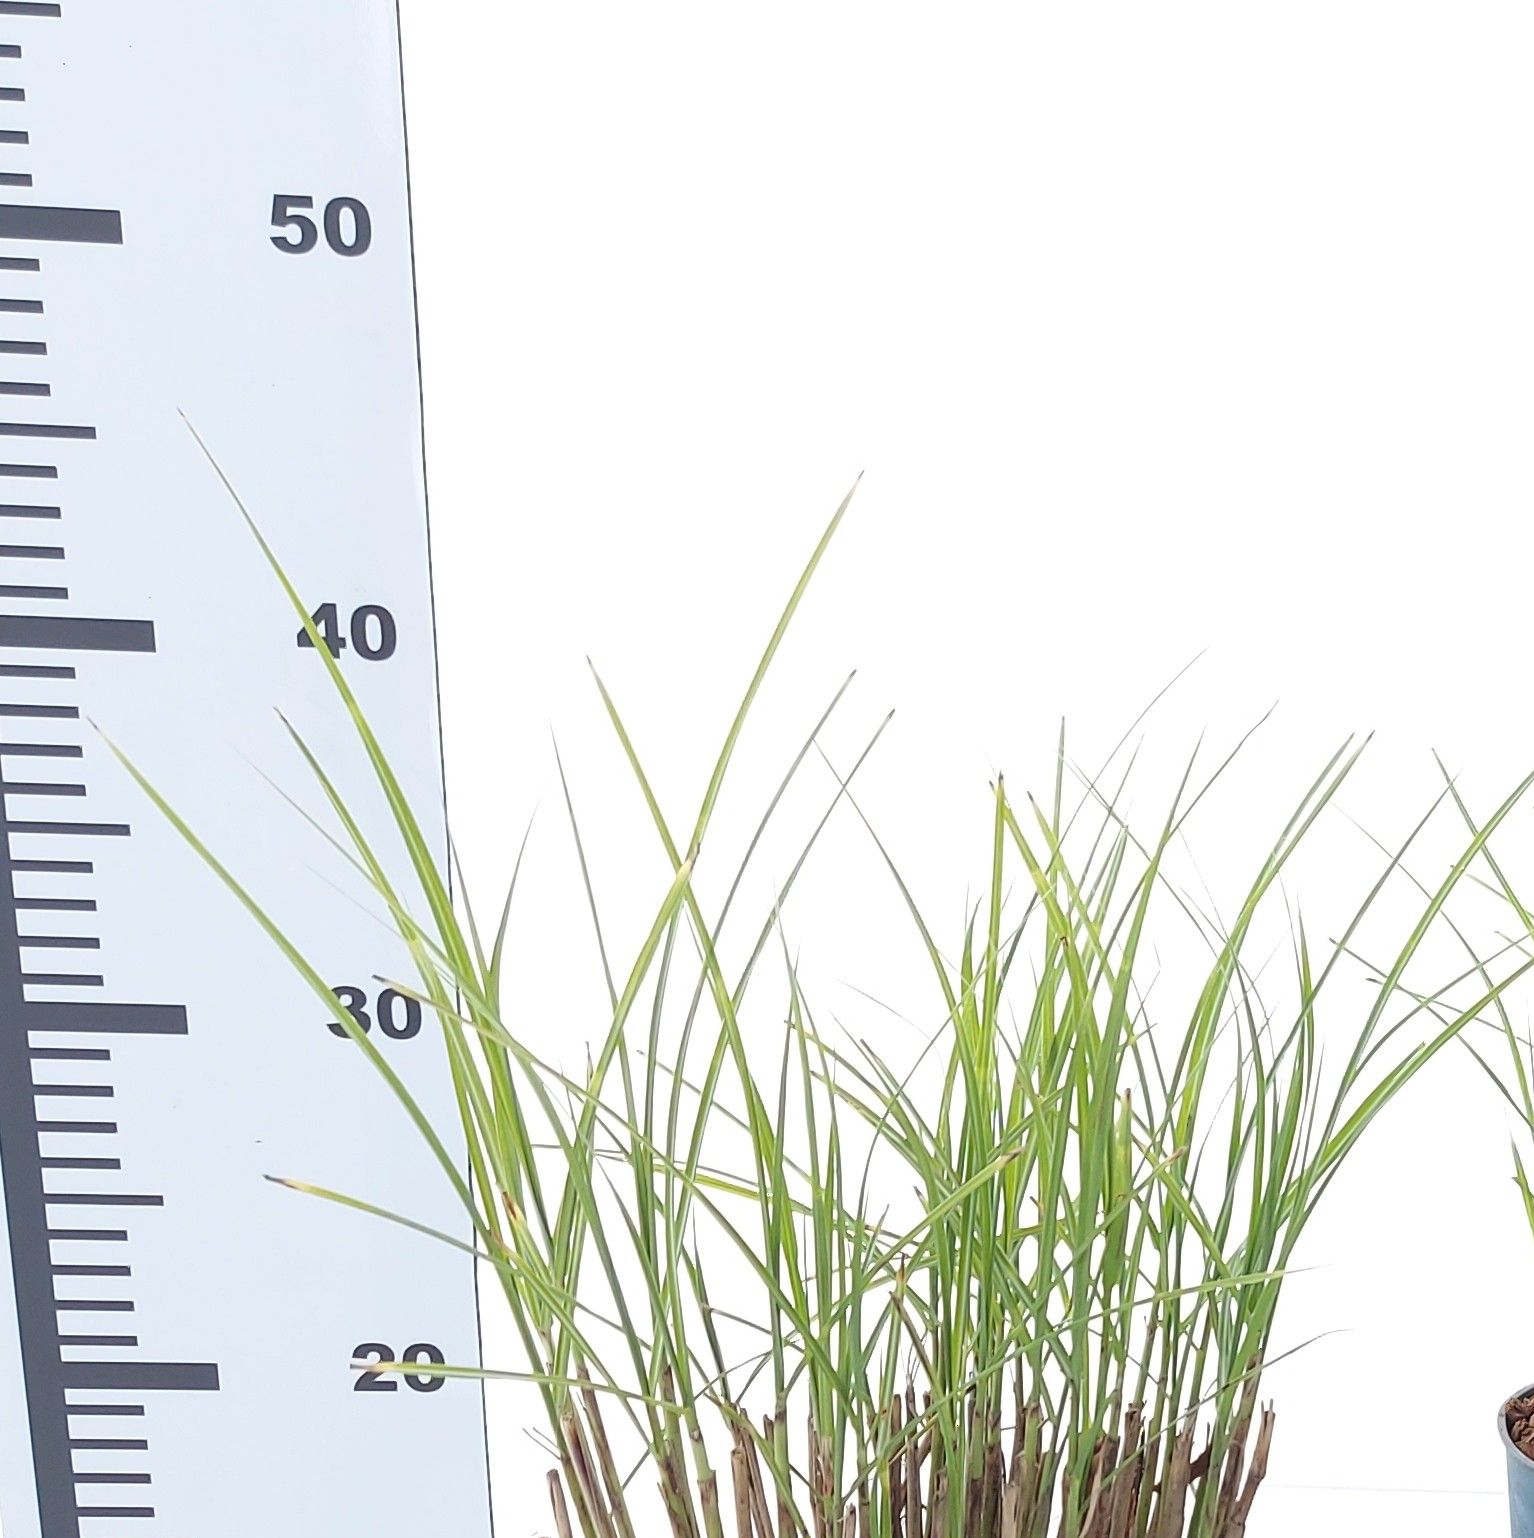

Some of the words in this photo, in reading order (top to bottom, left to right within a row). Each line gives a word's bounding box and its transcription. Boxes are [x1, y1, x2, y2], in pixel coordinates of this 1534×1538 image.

[270, 193, 372, 257] 50
[297, 603, 396, 661] 40
[326, 985, 422, 1040] 30
[350, 1341, 446, 1392] 20
